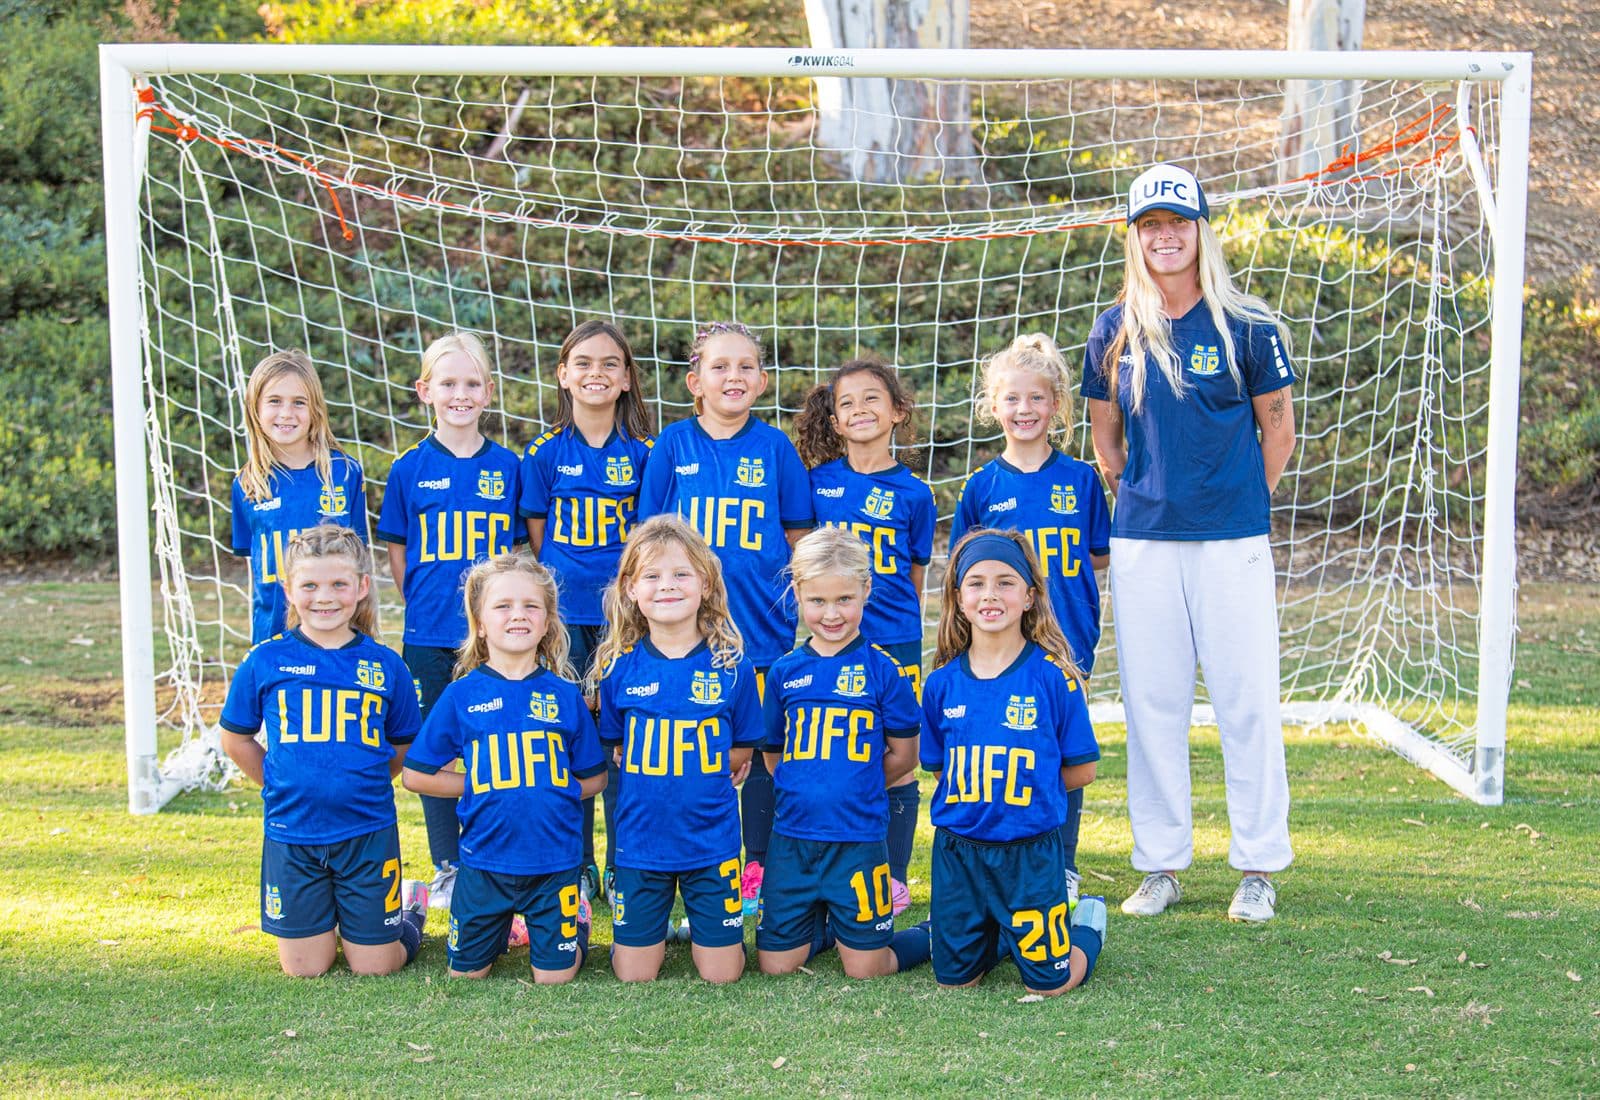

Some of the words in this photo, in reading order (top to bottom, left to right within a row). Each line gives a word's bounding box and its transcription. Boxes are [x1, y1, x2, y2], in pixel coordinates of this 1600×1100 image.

[1134, 180, 1188, 207] LUFC
[418, 477, 451, 490] capelli
[557, 463, 584, 477] capelli
[816, 486, 845, 498] capelli
[553, 495, 635, 546] LUFC
[677, 496, 765, 551] UFC
[988, 496, 1017, 512] capelli
[418, 510, 511, 563] LUFC
[278, 664, 317, 676] capelli
[626, 682, 660, 697] capelli
[783, 674, 813, 690] capelli
[277, 688, 383, 748] LUFC
[467, 697, 503, 713] capelli
[625, 716, 723, 777] LUFC
[783, 706, 875, 763] LUFC
[470, 730, 569, 795] LUFC
[945, 745, 1036, 807] LUFC
[382, 857, 401, 913] 2
[558, 884, 581, 939] 9
[719, 857, 742, 914] 3
[850, 863, 893, 922] 10
[1011, 902, 1071, 962] 20
